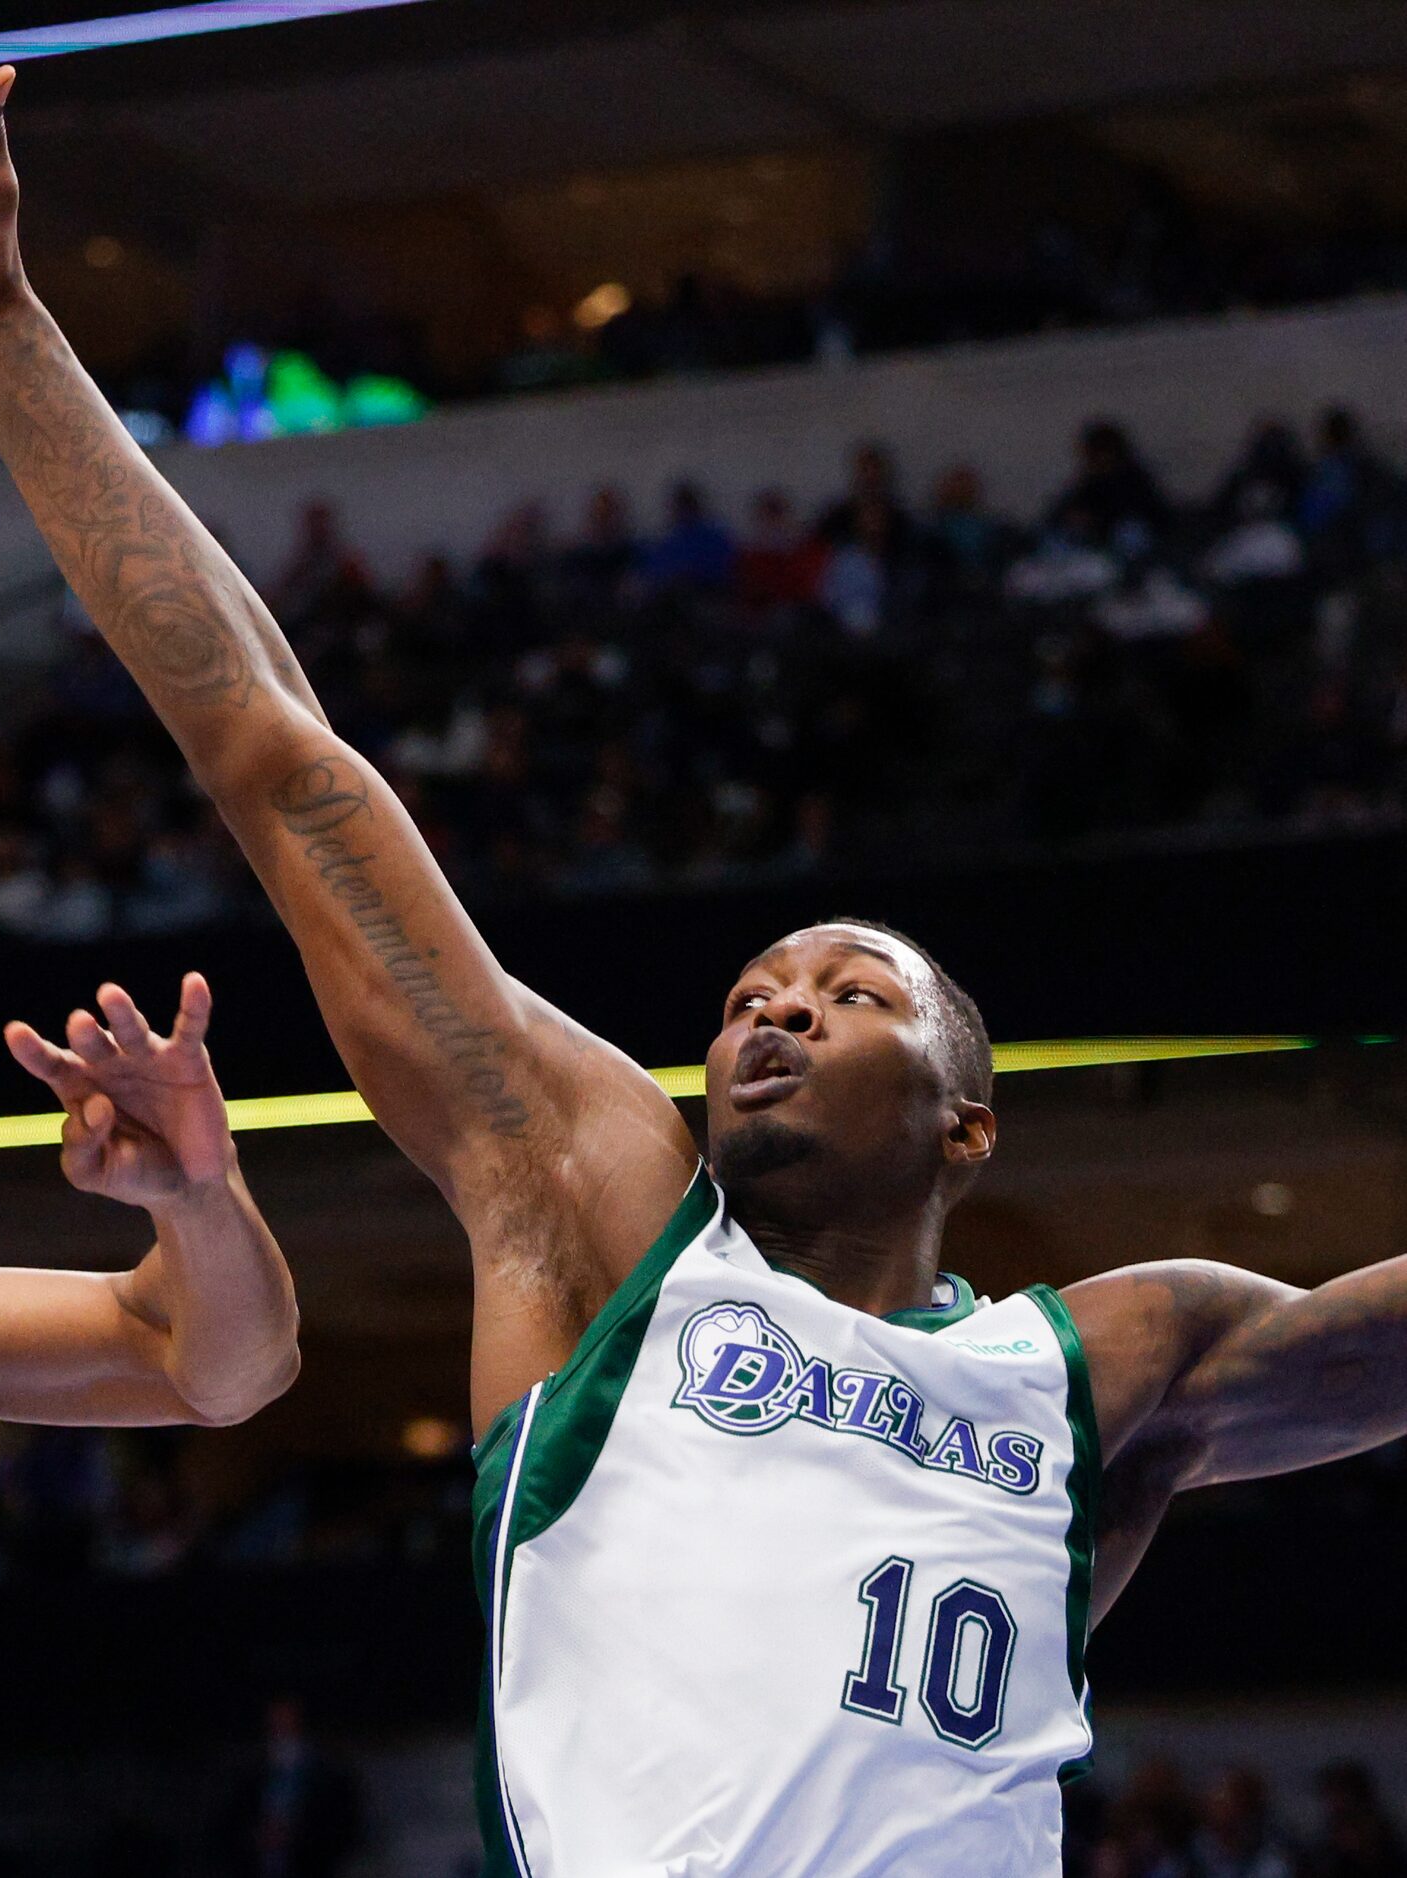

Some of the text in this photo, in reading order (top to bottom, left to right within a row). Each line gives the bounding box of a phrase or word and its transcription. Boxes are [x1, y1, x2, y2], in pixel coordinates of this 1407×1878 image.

[670, 1338, 1044, 1496] DALLAS
[945, 1338, 1040, 1355] hime
[840, 1554, 1018, 1752] 10
